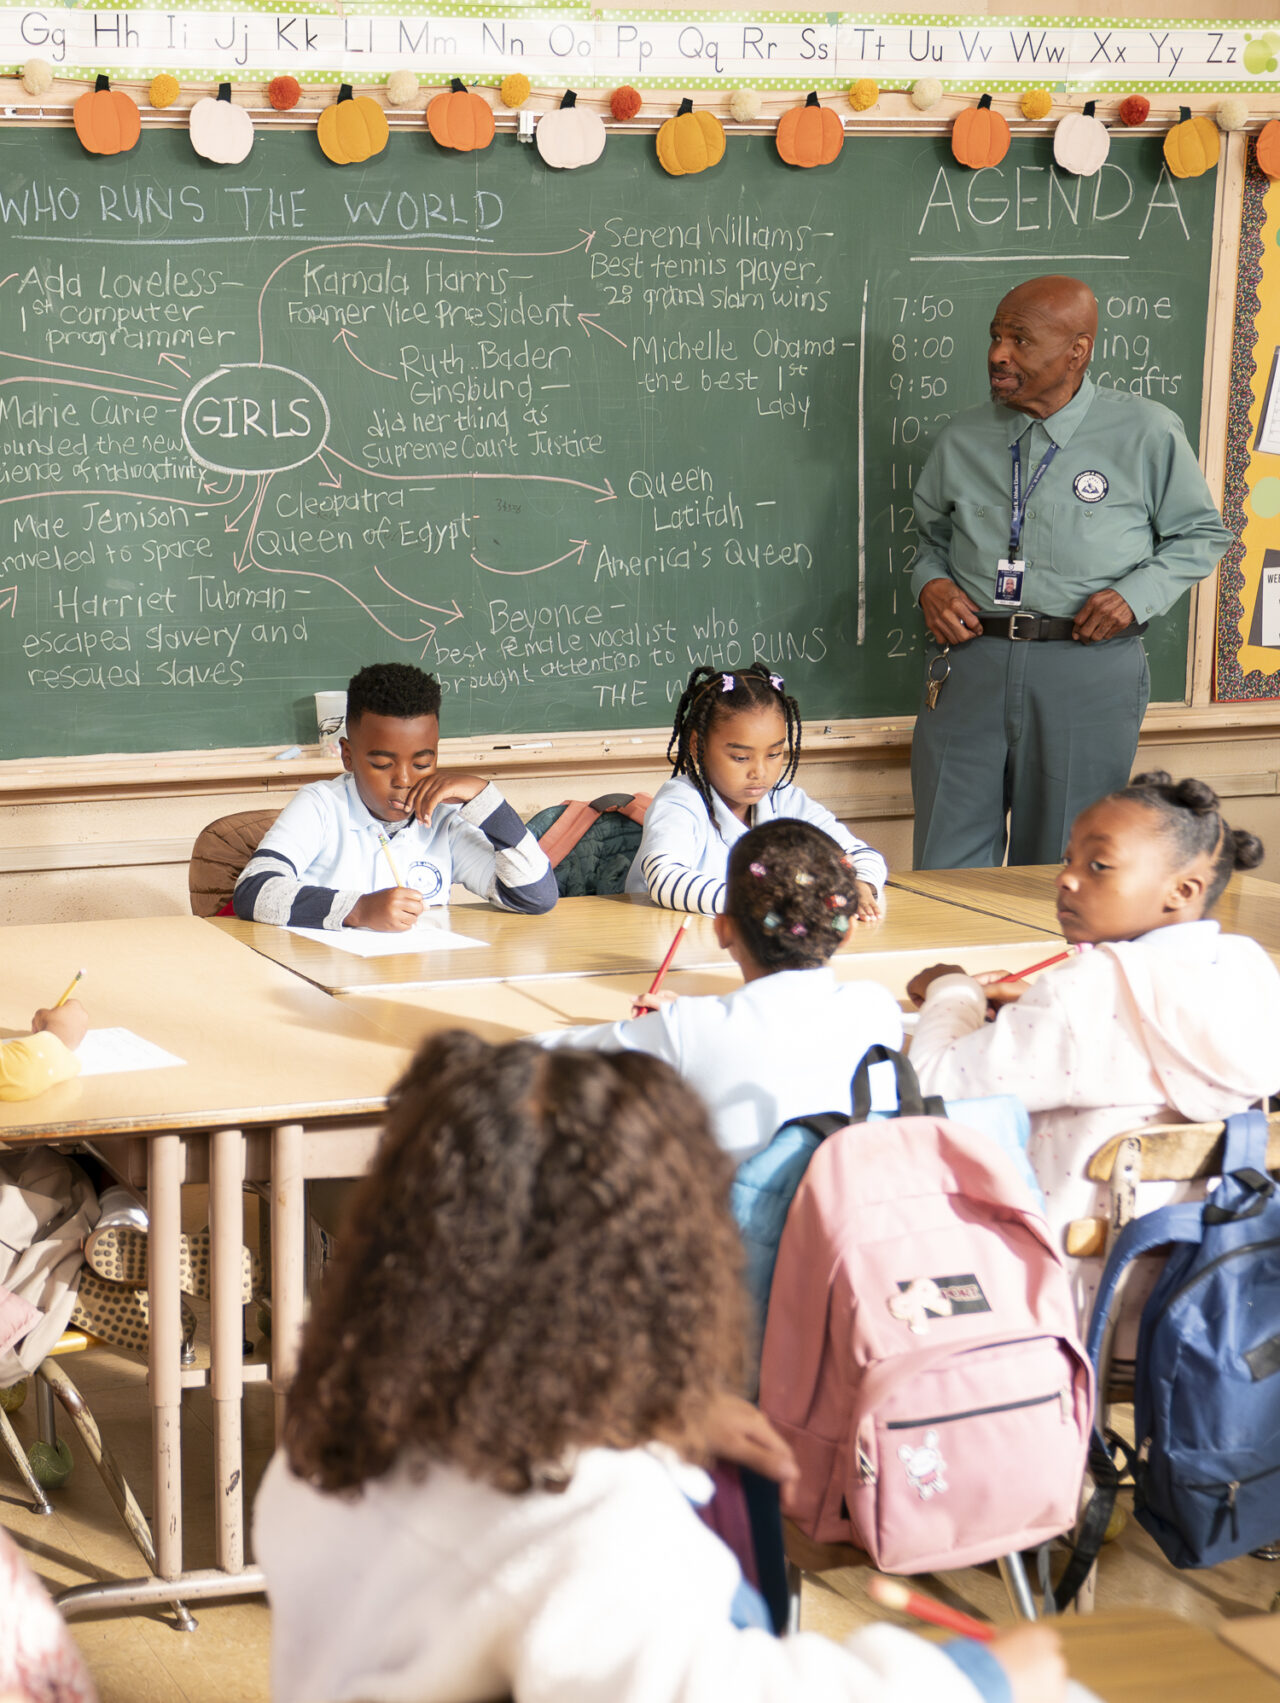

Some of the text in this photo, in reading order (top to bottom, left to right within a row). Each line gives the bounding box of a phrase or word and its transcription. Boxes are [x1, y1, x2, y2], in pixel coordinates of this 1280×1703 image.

[20, 11, 67, 62] Gg
[94, 13, 140, 48] Hh
[166, 15, 188, 50] Ii
[215, 16, 249, 65] Jj
[276, 17, 319, 52] Kk
[345, 19, 373, 53] Ll
[399, 20, 458, 55] Mm
[482, 22, 524, 56] Nn
[549, 24, 591, 58] Oo
[618, 25, 653, 72] Pp
[679, 26, 724, 73] Qq
[742, 26, 778, 60] Rr
[800, 27, 829, 60] Ss
[853, 28, 886, 60] Tt
[908, 30, 943, 62] Uu
[958, 30, 993, 63] Vv
[1010, 31, 1065, 63] Ww
[1090, 32, 1127, 64] Xx
[1149, 33, 1184, 77] Yy
[1206, 33, 1237, 65] Zz
[99, 185, 204, 224] RUNS
[224, 186, 306, 231] THE
[344, 189, 504, 231] WORLD
[918, 161, 1192, 241] AGENDA
[303, 257, 410, 298] Kamala
[590, 251, 644, 279] Best
[650, 251, 727, 278] tennis
[21, 300, 204, 332] 1st computer
[288, 294, 575, 328] Former Vice President
[643, 282, 831, 315] grand slam wins
[892, 295, 954, 324] 7:50
[45, 326, 236, 356] programmer
[632, 328, 738, 365] Michelle
[891, 332, 955, 362] 8:00
[400, 339, 571, 382] Ruth Bader
[638, 362, 808, 392] the best 1st
[889, 372, 948, 401] 9:50
[193, 396, 311, 439] GIRLS
[367, 404, 550, 438] did her thing as
[756, 392, 810, 428] Lady
[96, 433, 135, 455] the
[142, 434, 184, 453] new
[362, 429, 606, 468] Supreme Court Justice
[72, 456, 91, 484] of
[94, 455, 208, 494] radioactivity
[628, 465, 713, 500] Queen
[13, 513, 69, 543] Mae
[256, 512, 471, 556] Queen of Egypt
[106, 545, 133, 565] to
[593, 538, 813, 582] America's Queen
[54, 582, 177, 624] Harriet
[22, 617, 308, 658] escaped slavery and
[434, 606, 739, 665] best female vocalist who
[28, 657, 245, 690] rescued slaves
[436, 625, 828, 696] brought attention to WHO RUNS
[592, 679, 648, 709] THE
